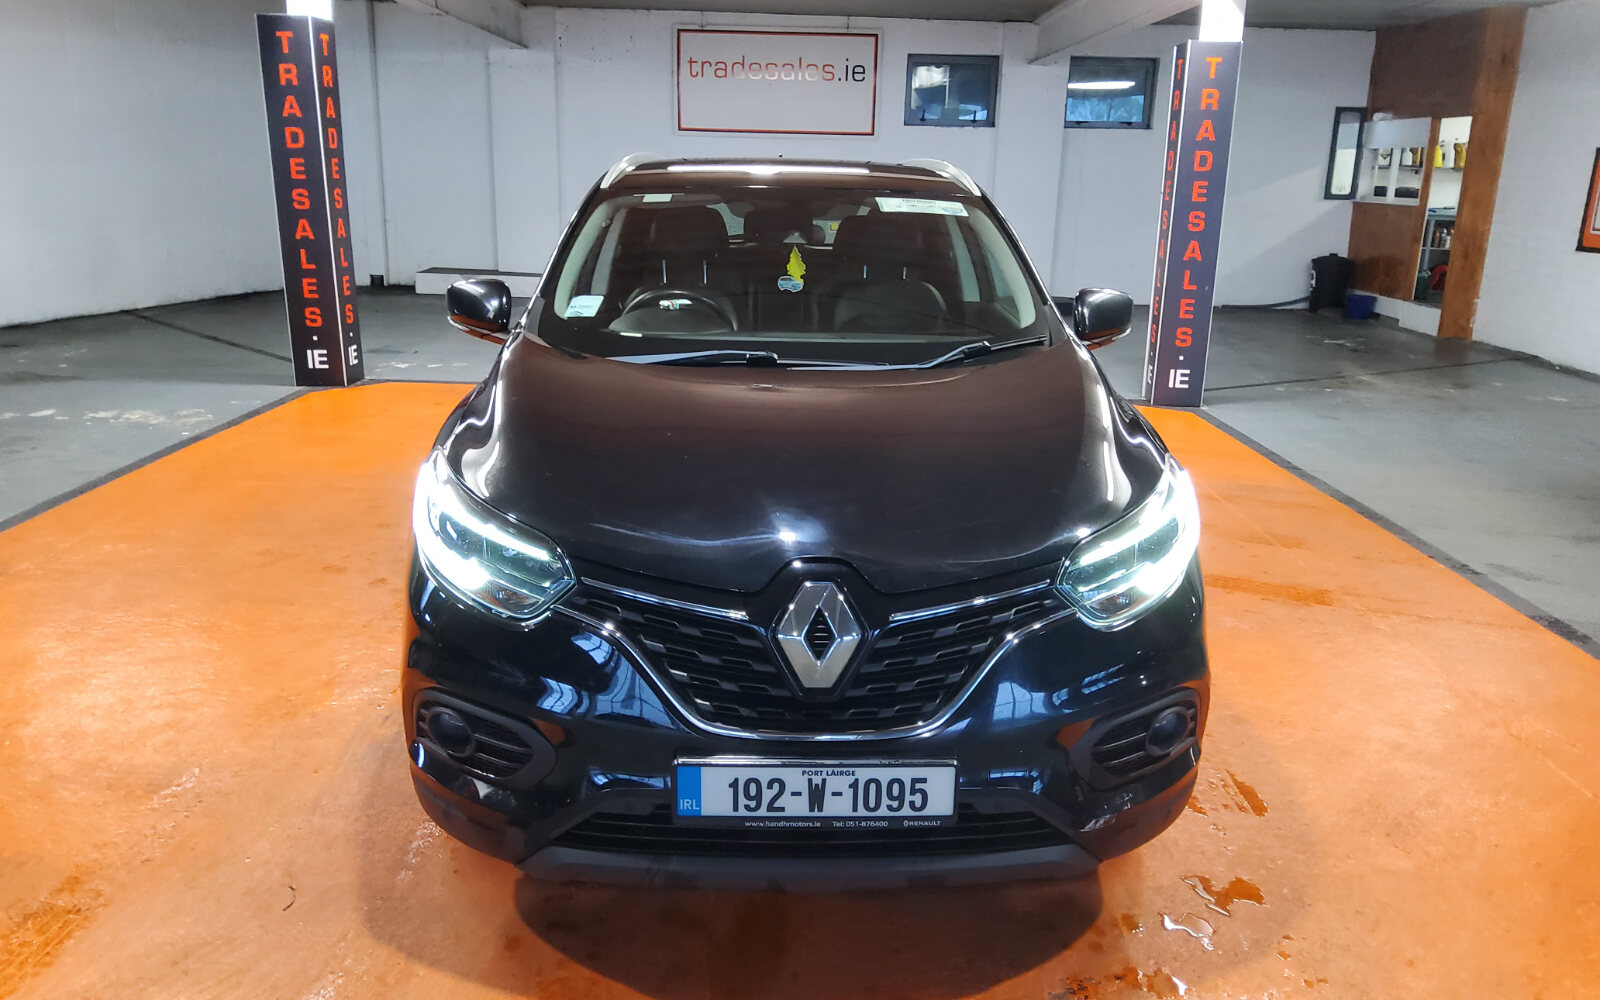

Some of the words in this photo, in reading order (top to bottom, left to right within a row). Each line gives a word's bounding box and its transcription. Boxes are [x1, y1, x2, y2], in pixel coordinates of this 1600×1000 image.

[687, 55, 866, 82] tradesales.ie
[801, 769, 824, 777] PORT
[679, 798, 701, 811] IRL
[728, 777, 929, 813] 192-W-1095
